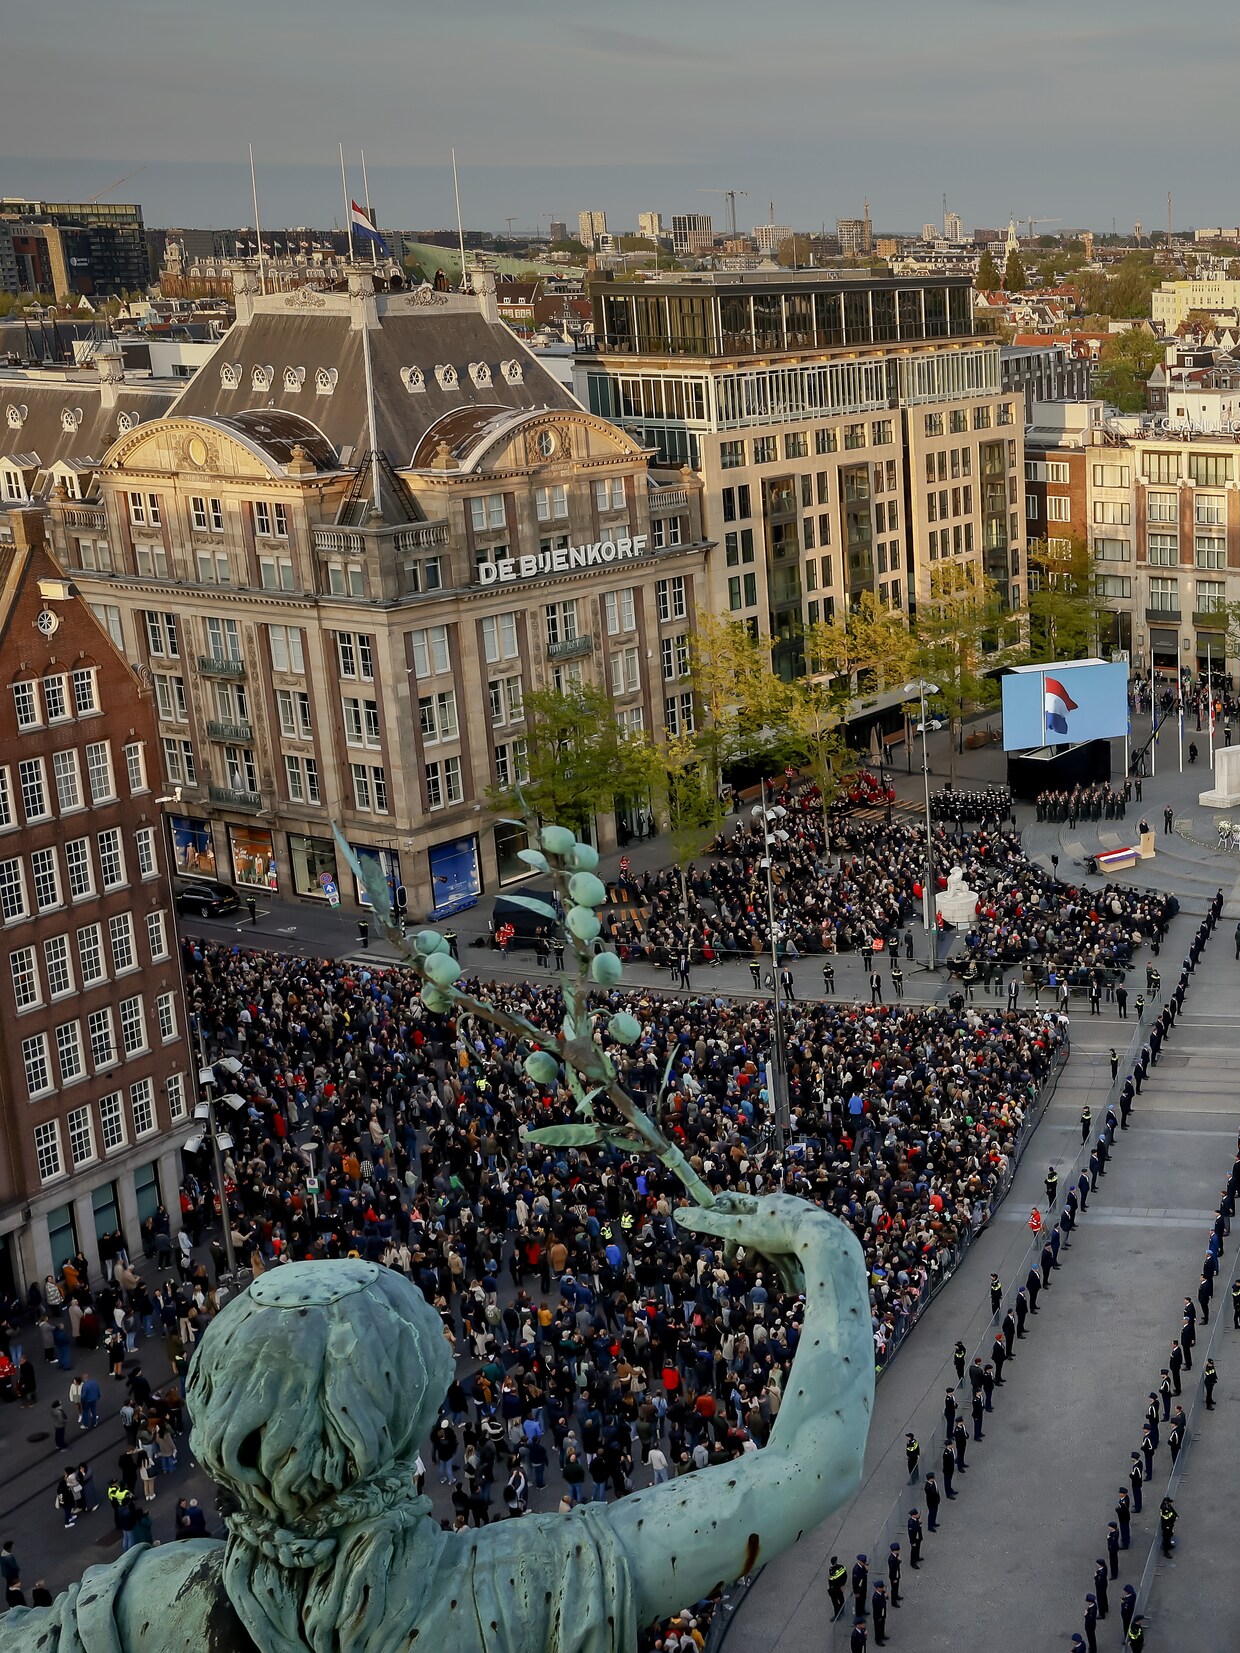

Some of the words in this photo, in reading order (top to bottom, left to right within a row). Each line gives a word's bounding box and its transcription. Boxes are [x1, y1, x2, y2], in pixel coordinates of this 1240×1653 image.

[1161, 417, 1215, 432] GRAND
[479, 557, 517, 585] DE
[520, 535, 648, 577] BIJENKORF
